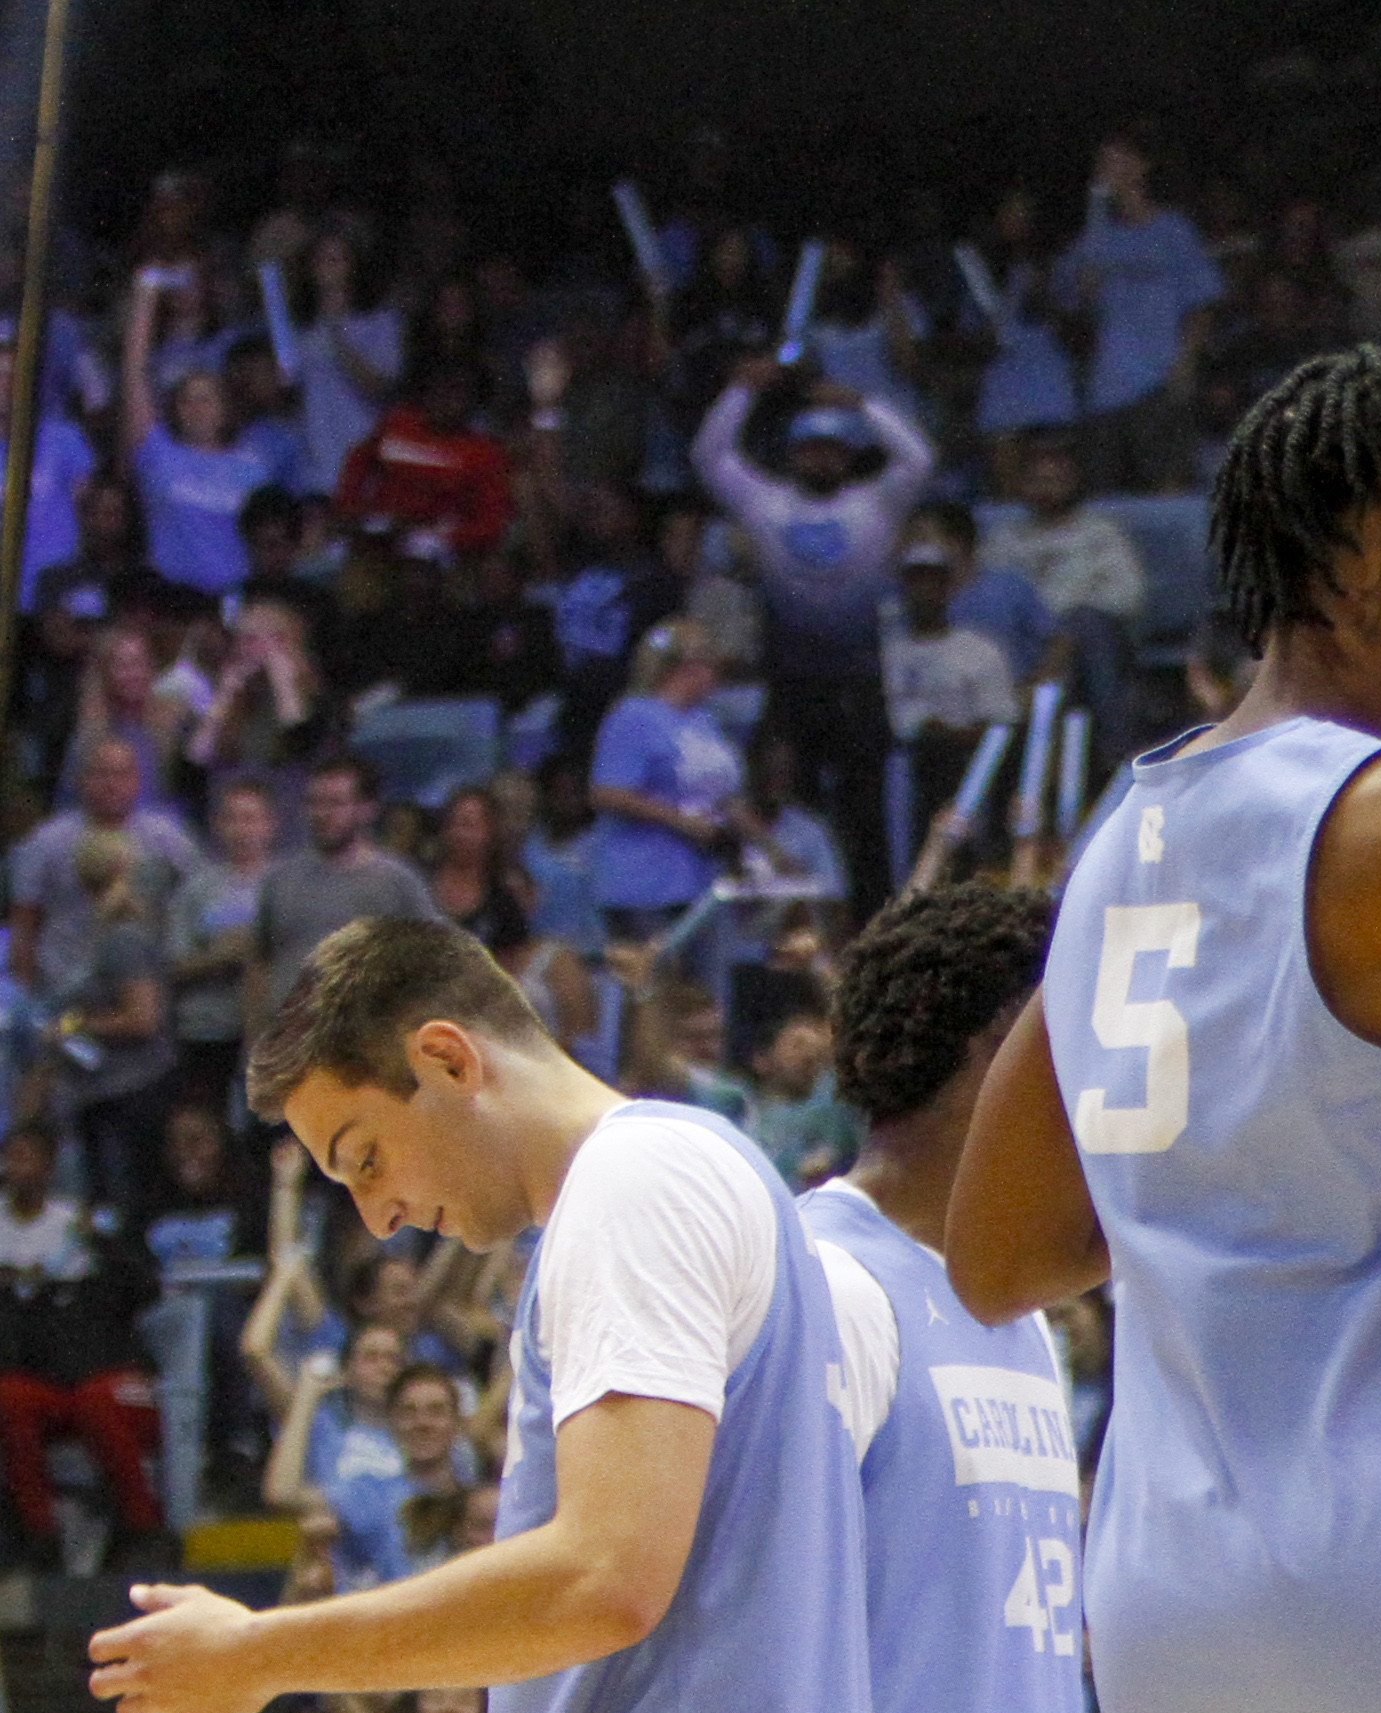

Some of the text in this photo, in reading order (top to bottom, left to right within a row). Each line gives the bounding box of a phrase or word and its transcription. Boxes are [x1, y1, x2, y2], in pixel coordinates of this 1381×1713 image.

[1075, 902, 1201, 1154] 5
[951, 1397, 1076, 1463] CAROLIN
[1003, 1536, 1075, 1656] 42
